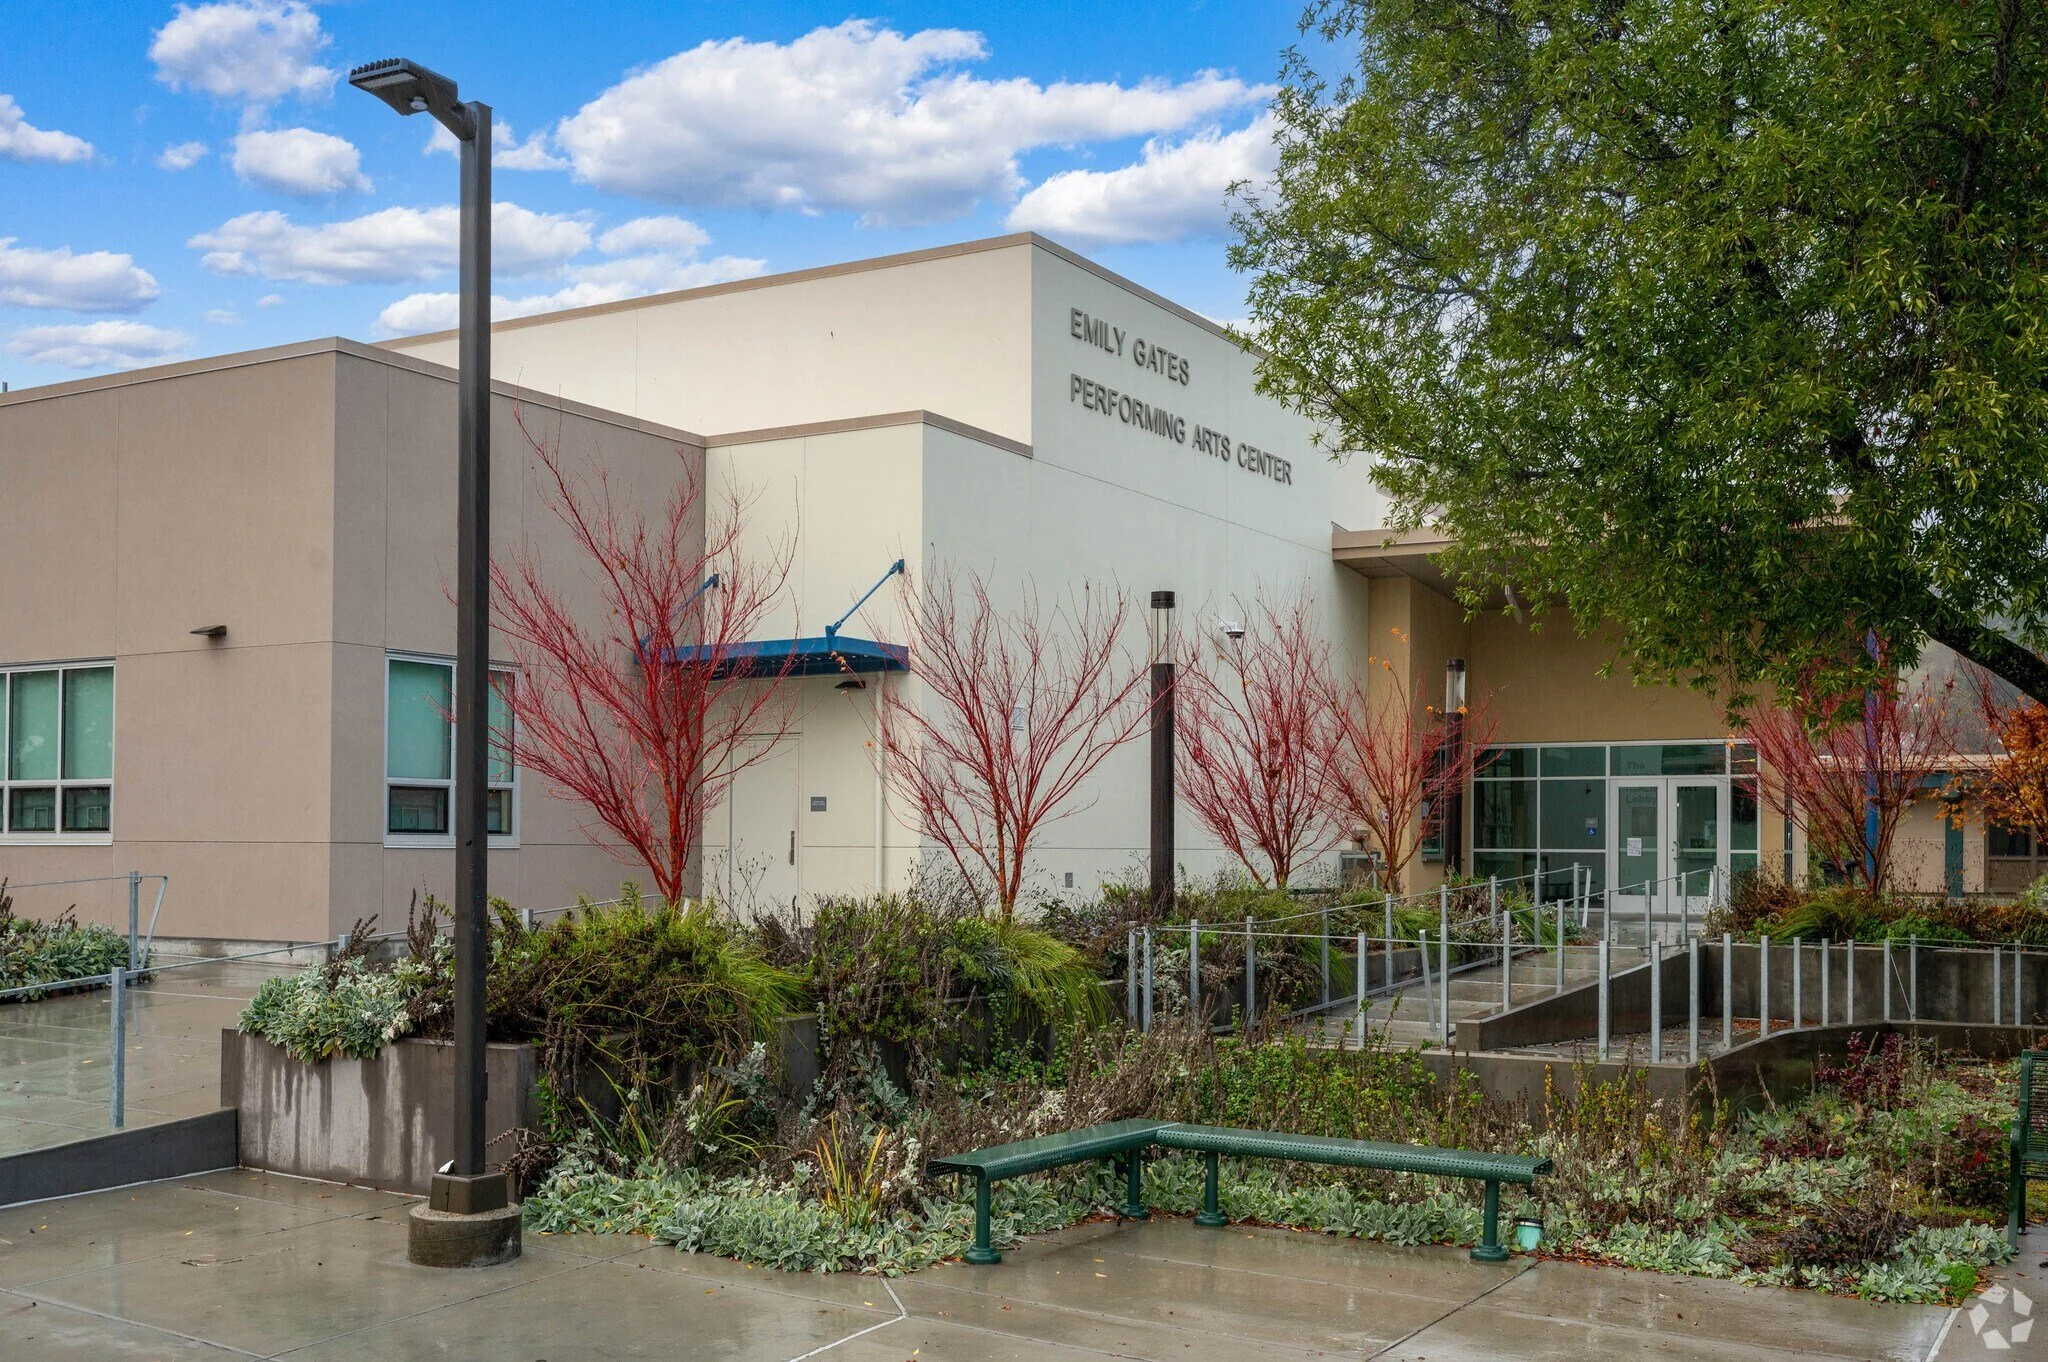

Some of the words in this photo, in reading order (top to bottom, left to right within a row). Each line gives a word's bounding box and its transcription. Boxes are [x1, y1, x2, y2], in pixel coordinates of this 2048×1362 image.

[1070, 307, 1126, 356] EMILY
[1133, 338, 1190, 386] GATES
[1070, 373, 1186, 443] PERFORMING
[1192, 424, 1231, 462] ARTS
[1237, 442, 1292, 485] CENTER
[1626, 794, 1656, 805] Lobby
